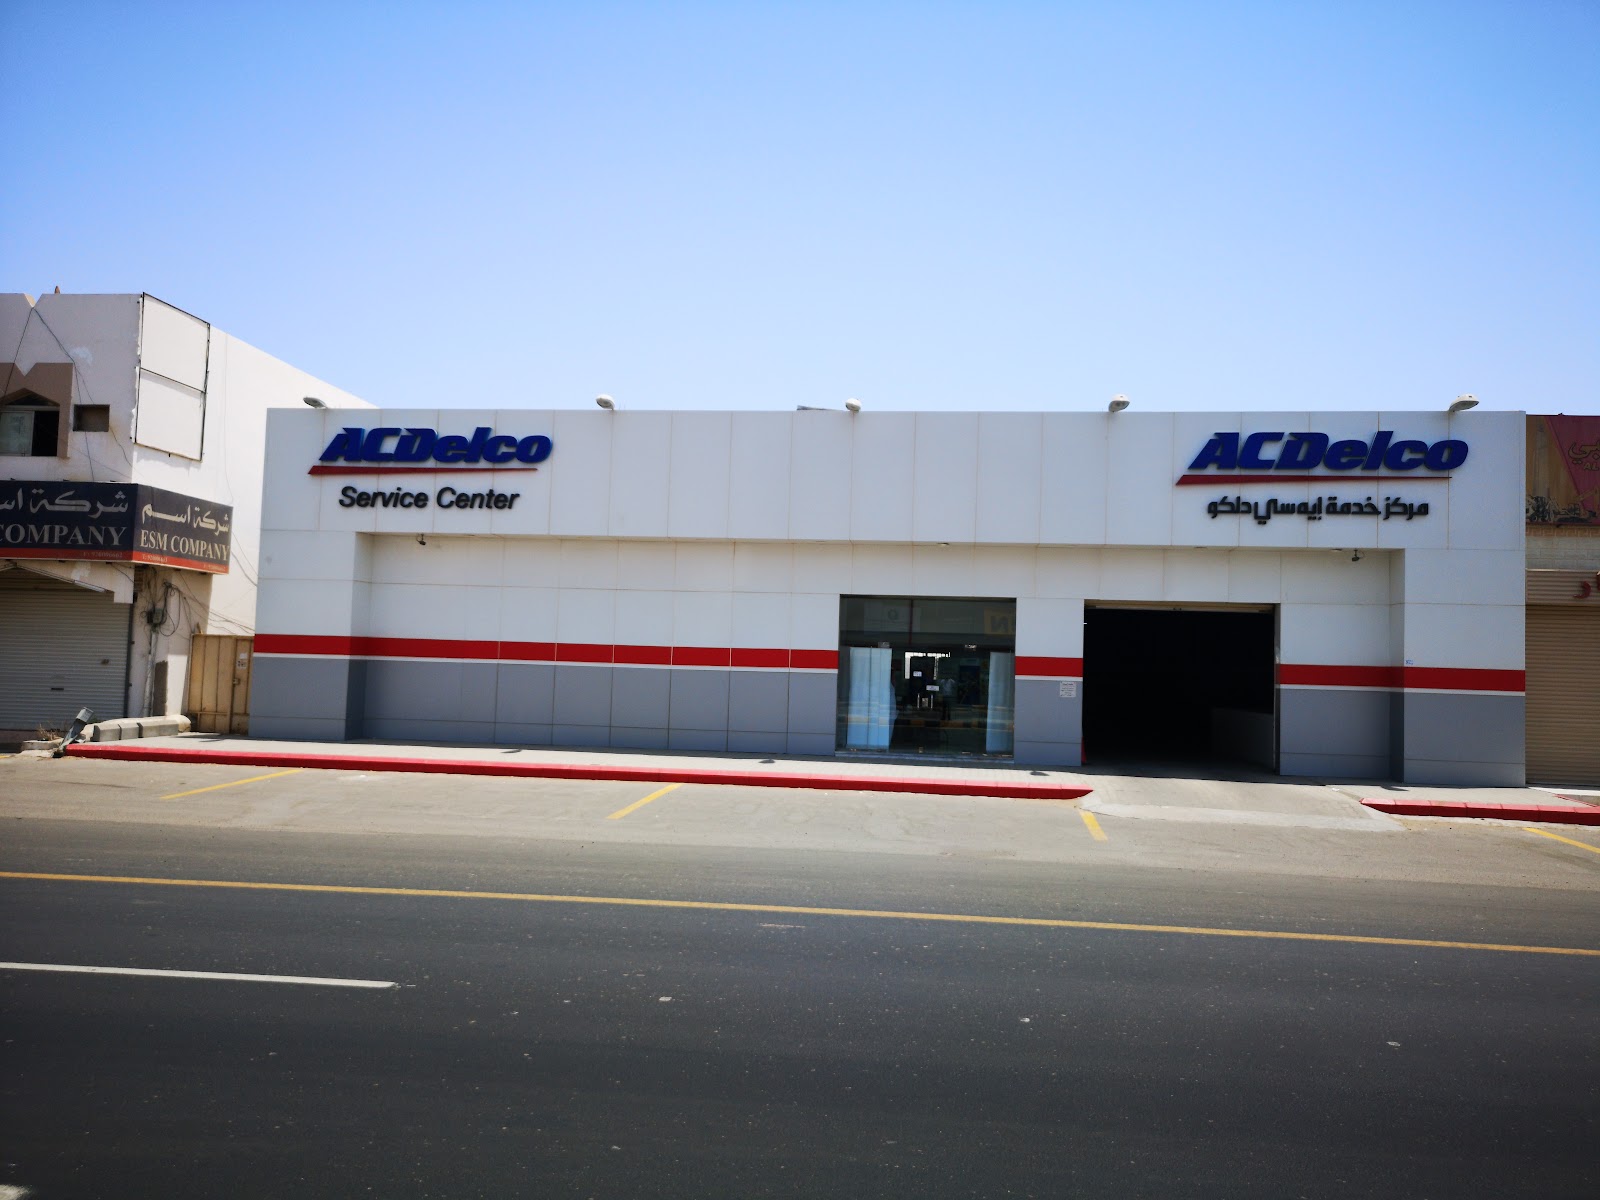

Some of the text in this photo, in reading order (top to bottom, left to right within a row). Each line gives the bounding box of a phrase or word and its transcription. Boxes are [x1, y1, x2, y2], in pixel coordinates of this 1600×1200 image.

[318, 426, 553, 464] ACDelco
[1187, 430, 1469, 472] ACDelco
[29, 488, 129, 519] شركة
[338, 485, 520, 510] Service Center
[1207, 495, 1252, 520] دلكو
[1326, 496, 1381, 516] خدمة
[1383, 496, 1429, 521] مركز
[142, 503, 230, 536] شركة اسم
[140, 529, 230, 561] ESM COMPANY
